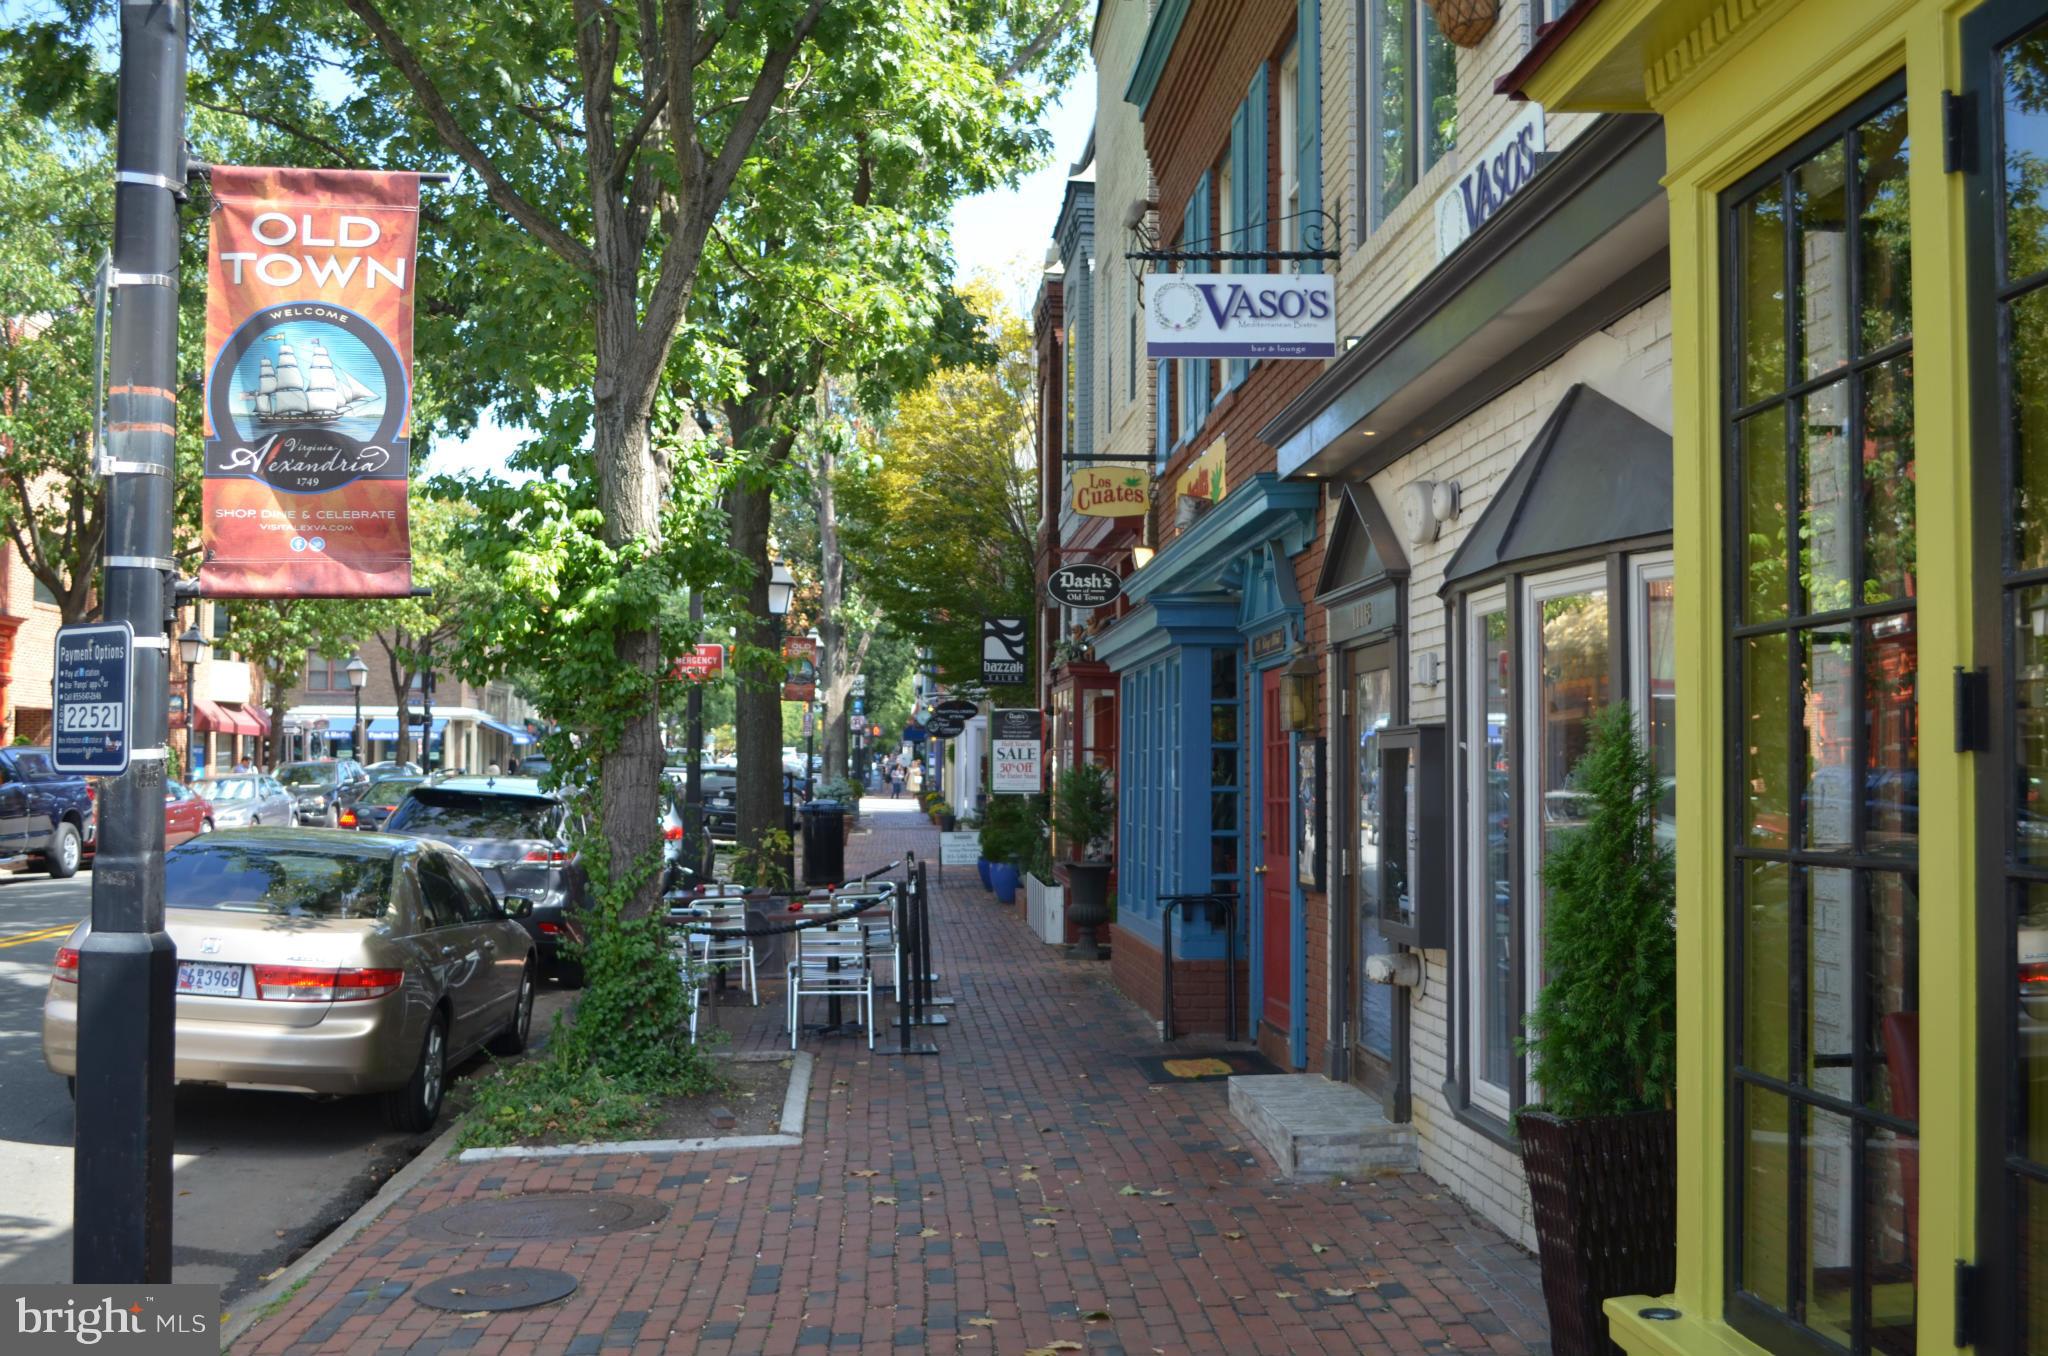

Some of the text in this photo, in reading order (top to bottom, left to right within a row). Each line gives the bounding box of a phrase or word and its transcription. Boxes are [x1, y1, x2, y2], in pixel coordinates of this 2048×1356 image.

[252, 212, 381, 248] OLD
[220, 252, 406, 290] TOWN
[270, 307, 349, 323] WELCOME
[1195, 284, 1329, 330] VASO'S
[1294, 320, 1318, 328] Bistro
[1251, 344, 1266, 352] bar
[1277, 344, 1306, 354] lounge
[219, 434, 390, 473] Alexandria
[284, 437, 339, 458] Virginia
[296, 477, 320, 487] 1749
[1089, 473, 1111, 489] Los
[1077, 485, 1144, 511] Cuates
[261, 510, 295, 519] DINE
[302, 510, 310, 519] &
[316, 510, 396, 519] CELEBRATE
[259, 523, 354, 532] VISITALEXVA.COM
[1060, 571, 1113, 589] Dash's
[1067, 593, 1105, 601] Old Town
[60, 644, 124, 665] Payment Options
[675, 656, 717, 665] MERGENCY
[983, 660, 1024, 673] bazzak
[67, 705, 118, 729] 22521
[997, 747, 1037, 760] SALE
